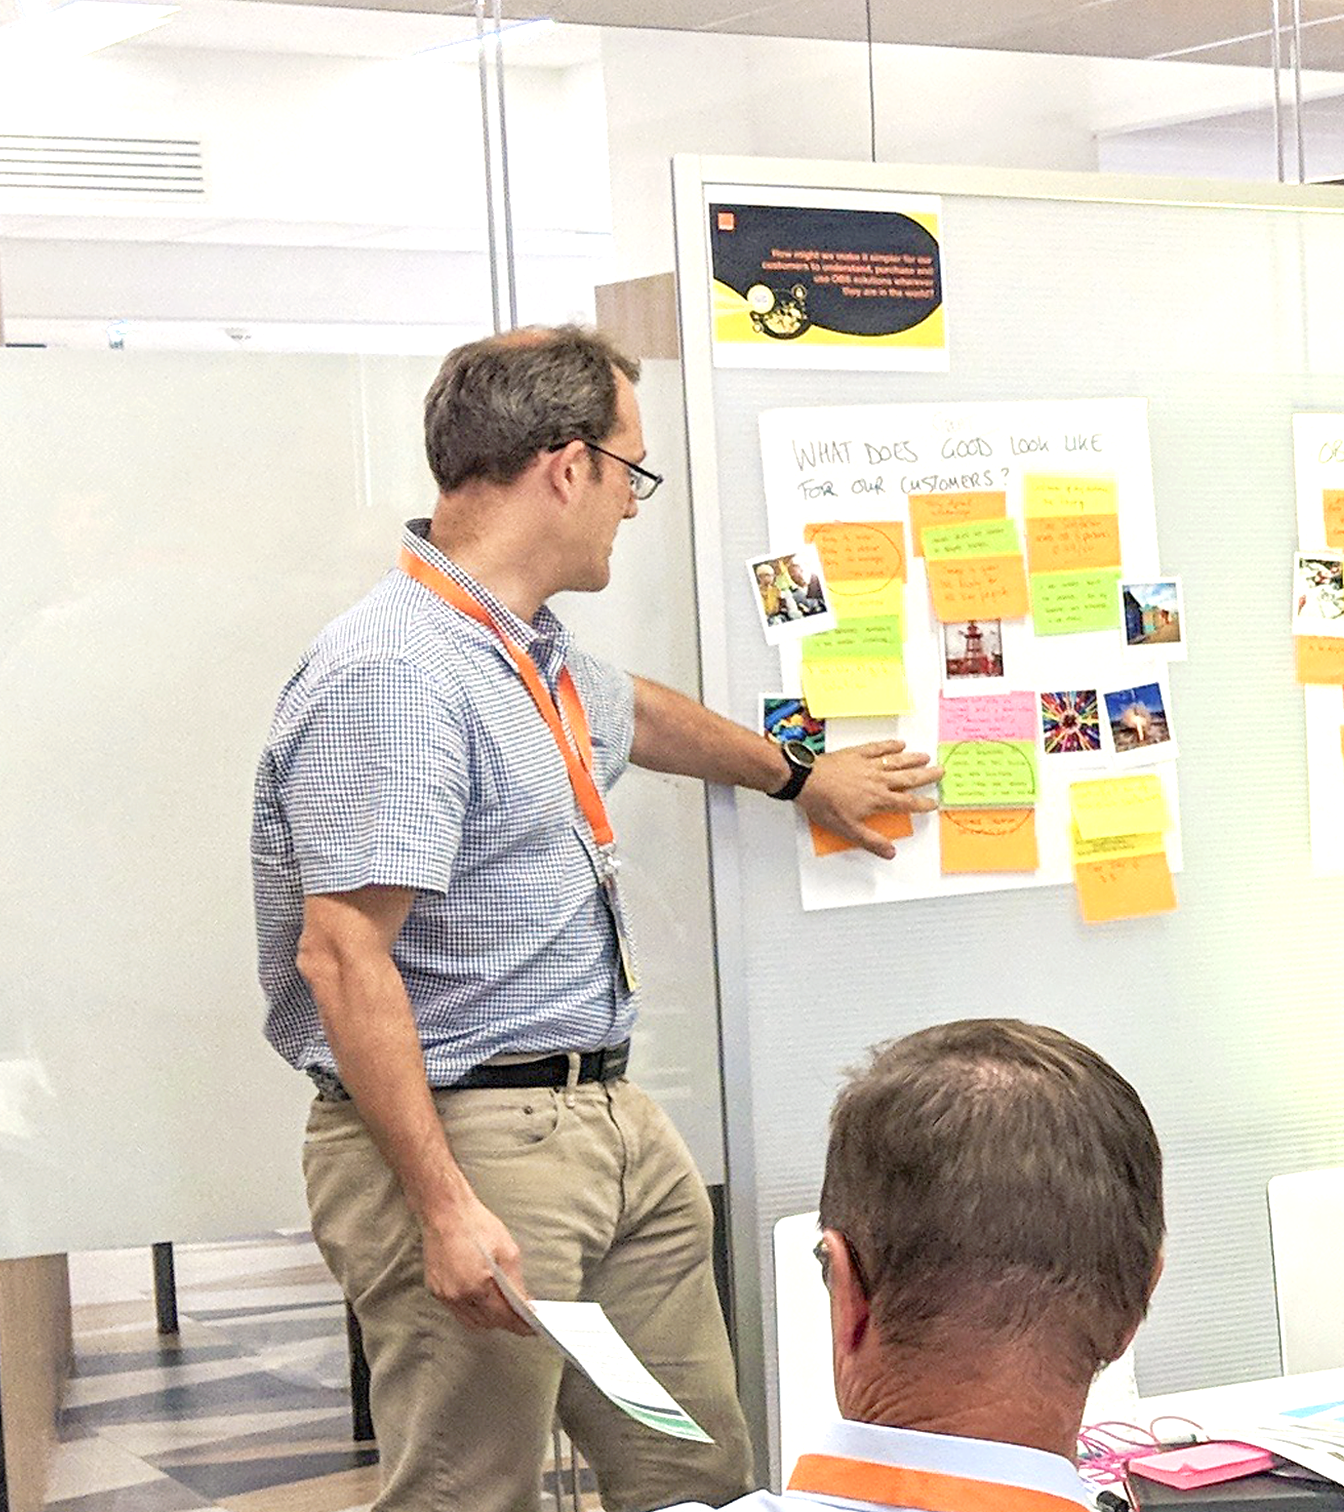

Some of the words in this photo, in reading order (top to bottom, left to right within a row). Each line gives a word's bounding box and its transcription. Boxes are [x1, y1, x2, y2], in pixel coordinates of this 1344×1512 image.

[791, 437, 854, 471] WHAT
[865, 439, 920, 465] DOES
[941, 435, 994, 460] GOOD
[797, 480, 840, 500] FOR
[849, 474, 887, 497] OUR
